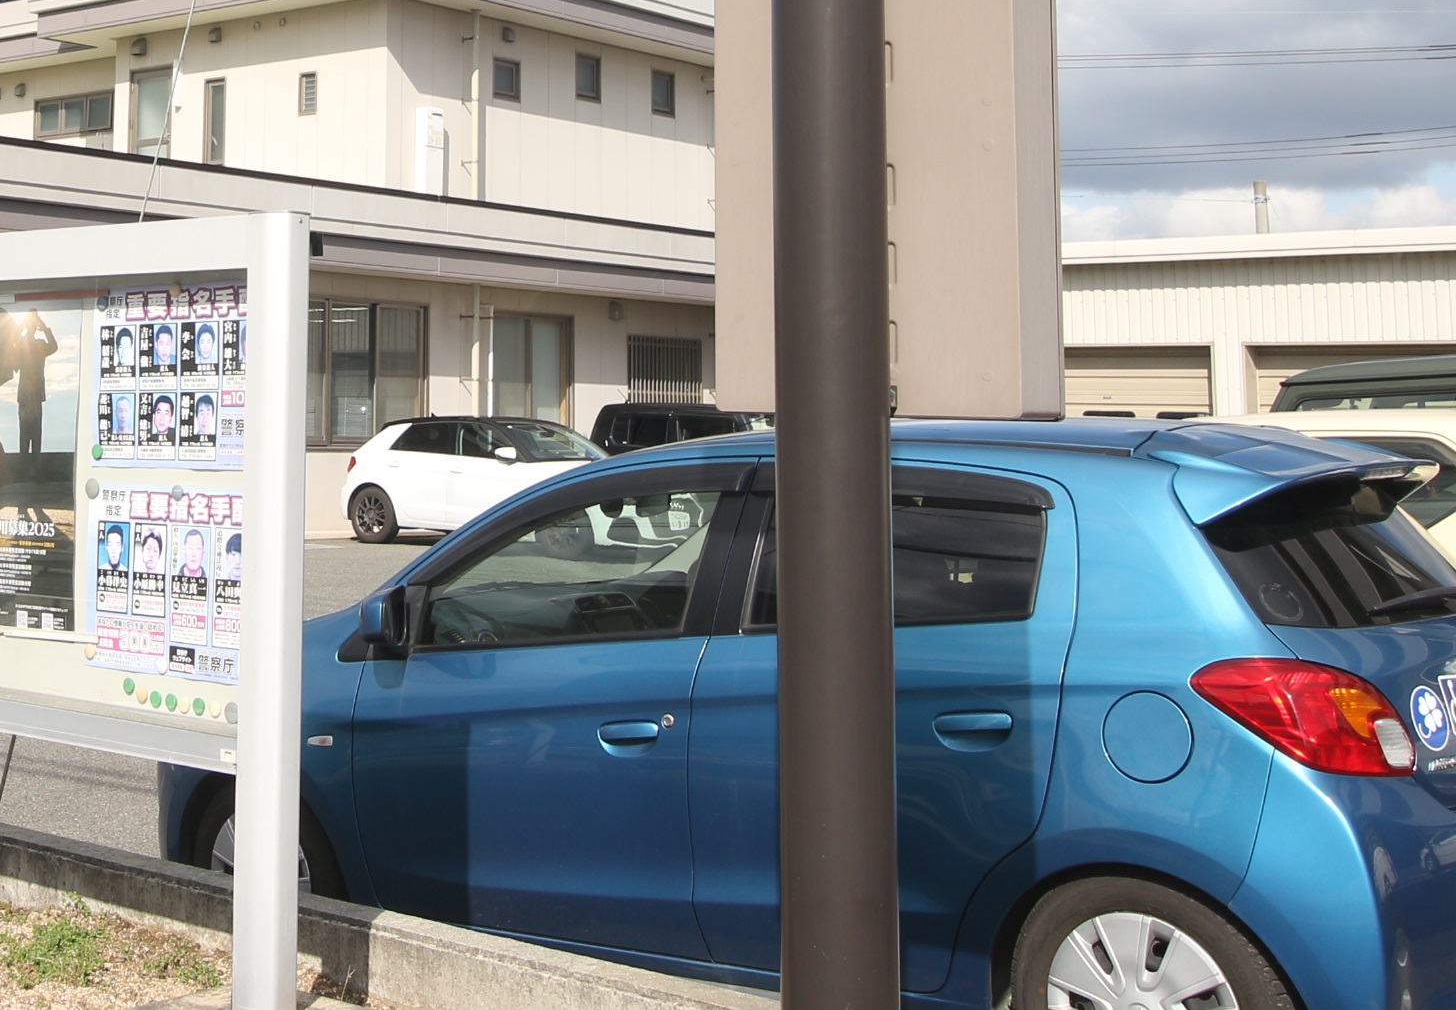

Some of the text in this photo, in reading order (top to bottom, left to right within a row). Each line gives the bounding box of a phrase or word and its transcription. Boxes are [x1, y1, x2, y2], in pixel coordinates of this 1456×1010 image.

[106, 505, 122, 516] 指定
[198, 654, 235, 675] 警察庁
